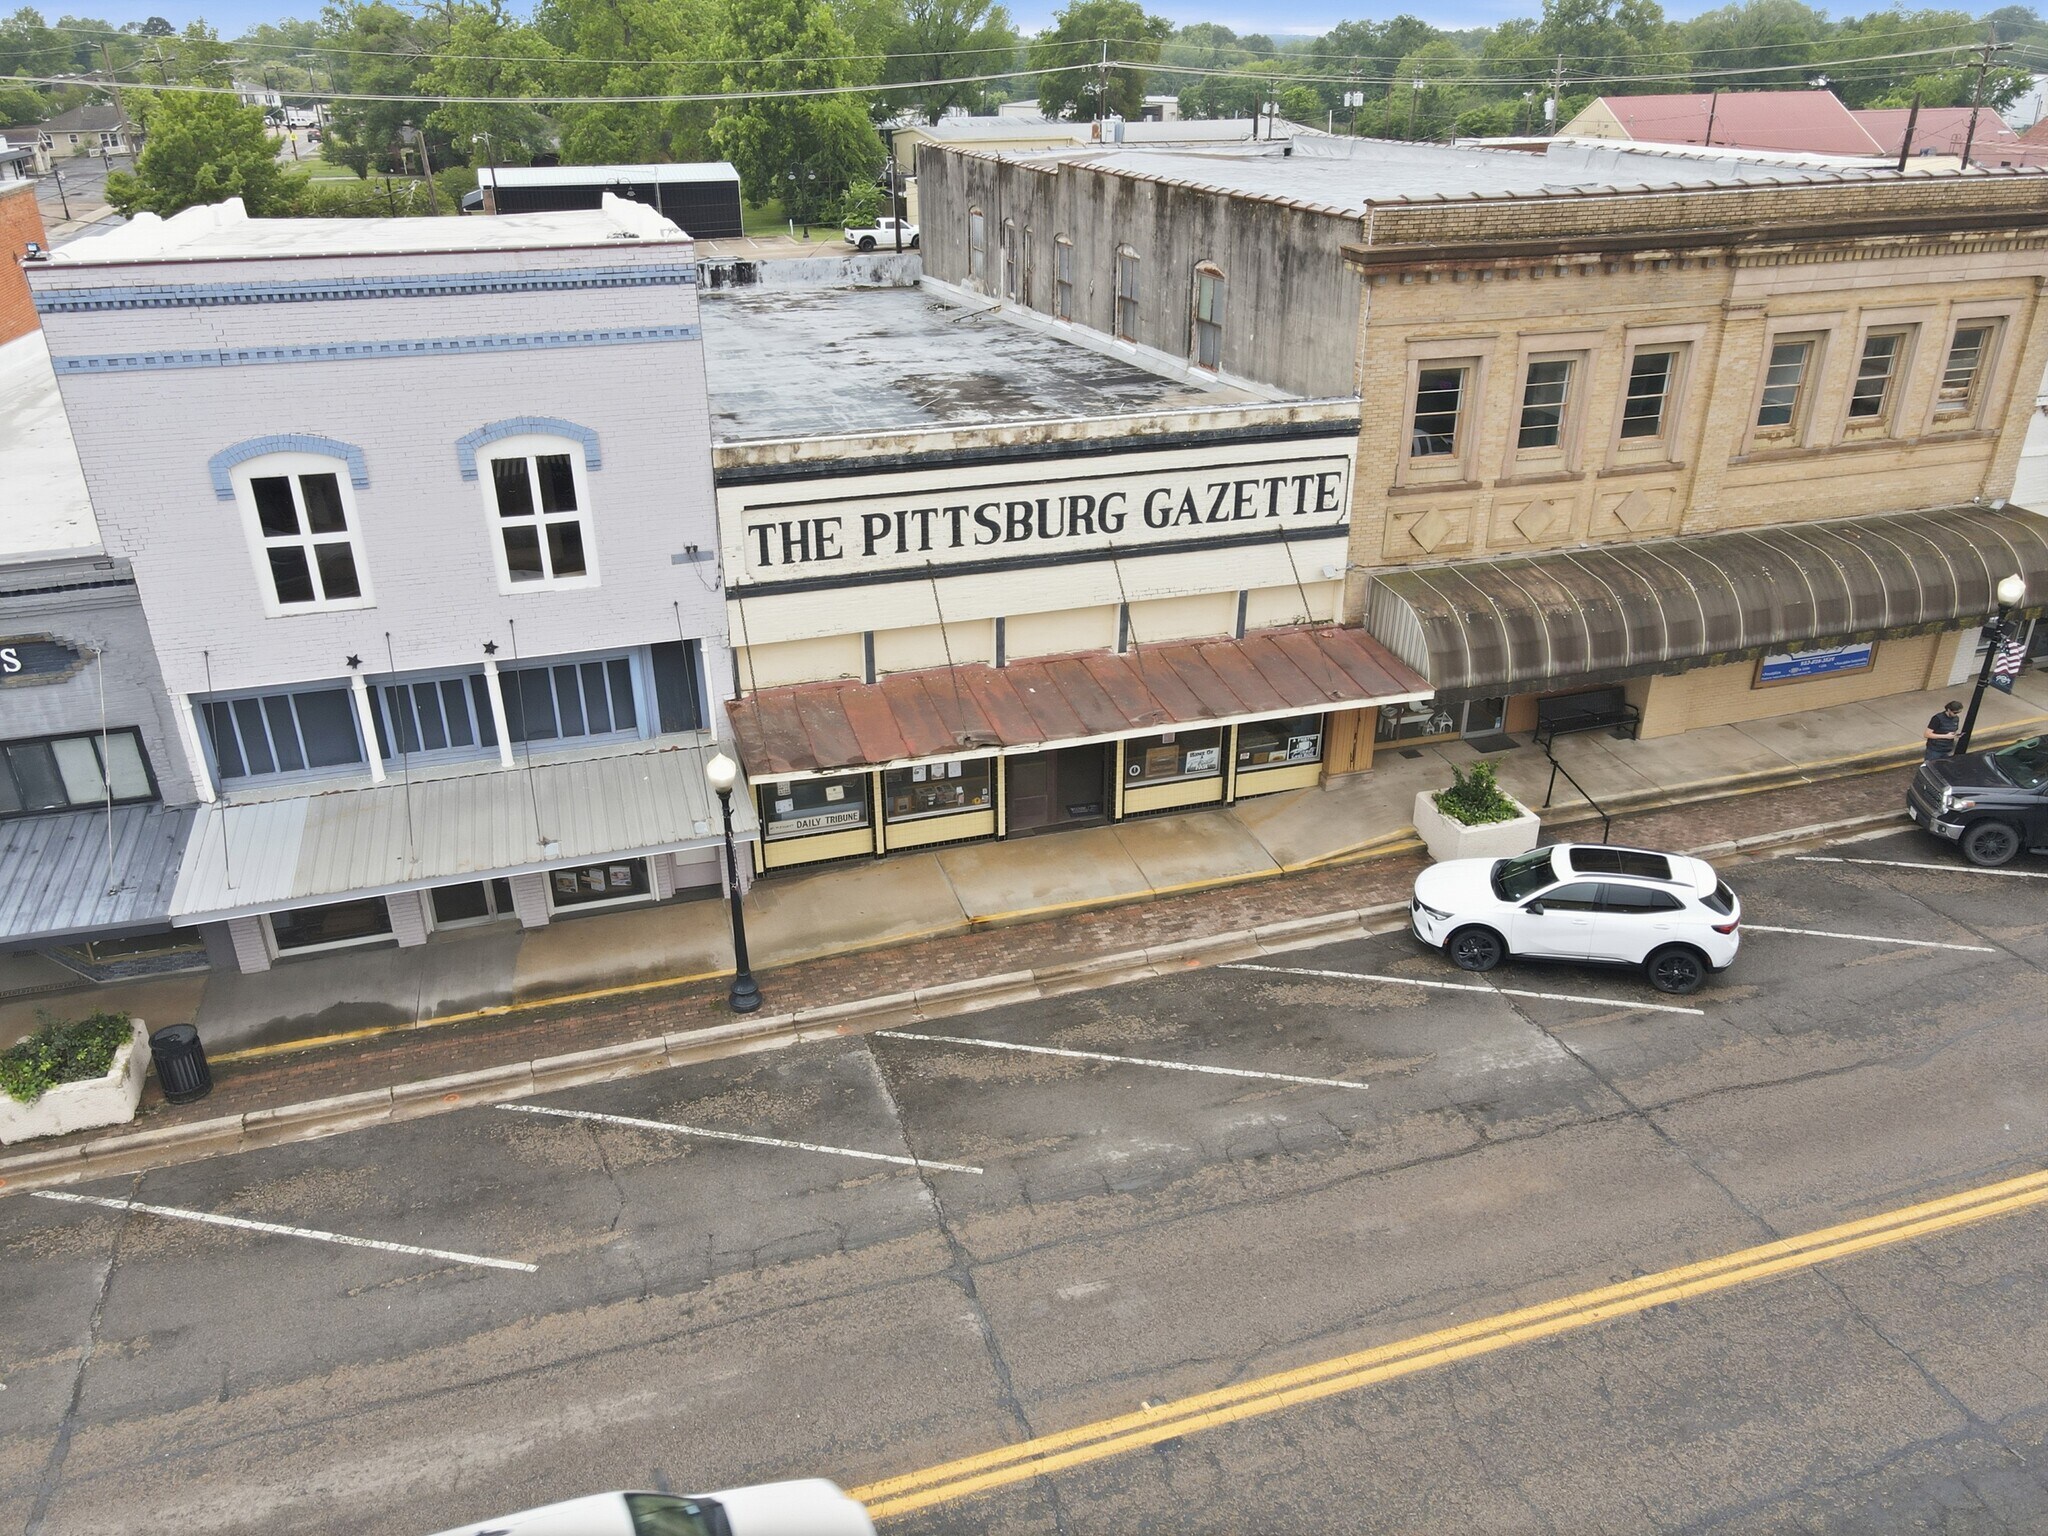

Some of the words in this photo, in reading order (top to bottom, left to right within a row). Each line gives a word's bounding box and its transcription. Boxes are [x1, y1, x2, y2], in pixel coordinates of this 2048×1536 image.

[748, 516, 843, 567] THE
[861, 492, 1128, 557] PITTSBURG
[1143, 471, 1342, 529] GAZETTE
[0, 648, 22, 673] S
[796, 818, 821, 829] DAILY
[825, 812, 858, 824] TRIBUNE
